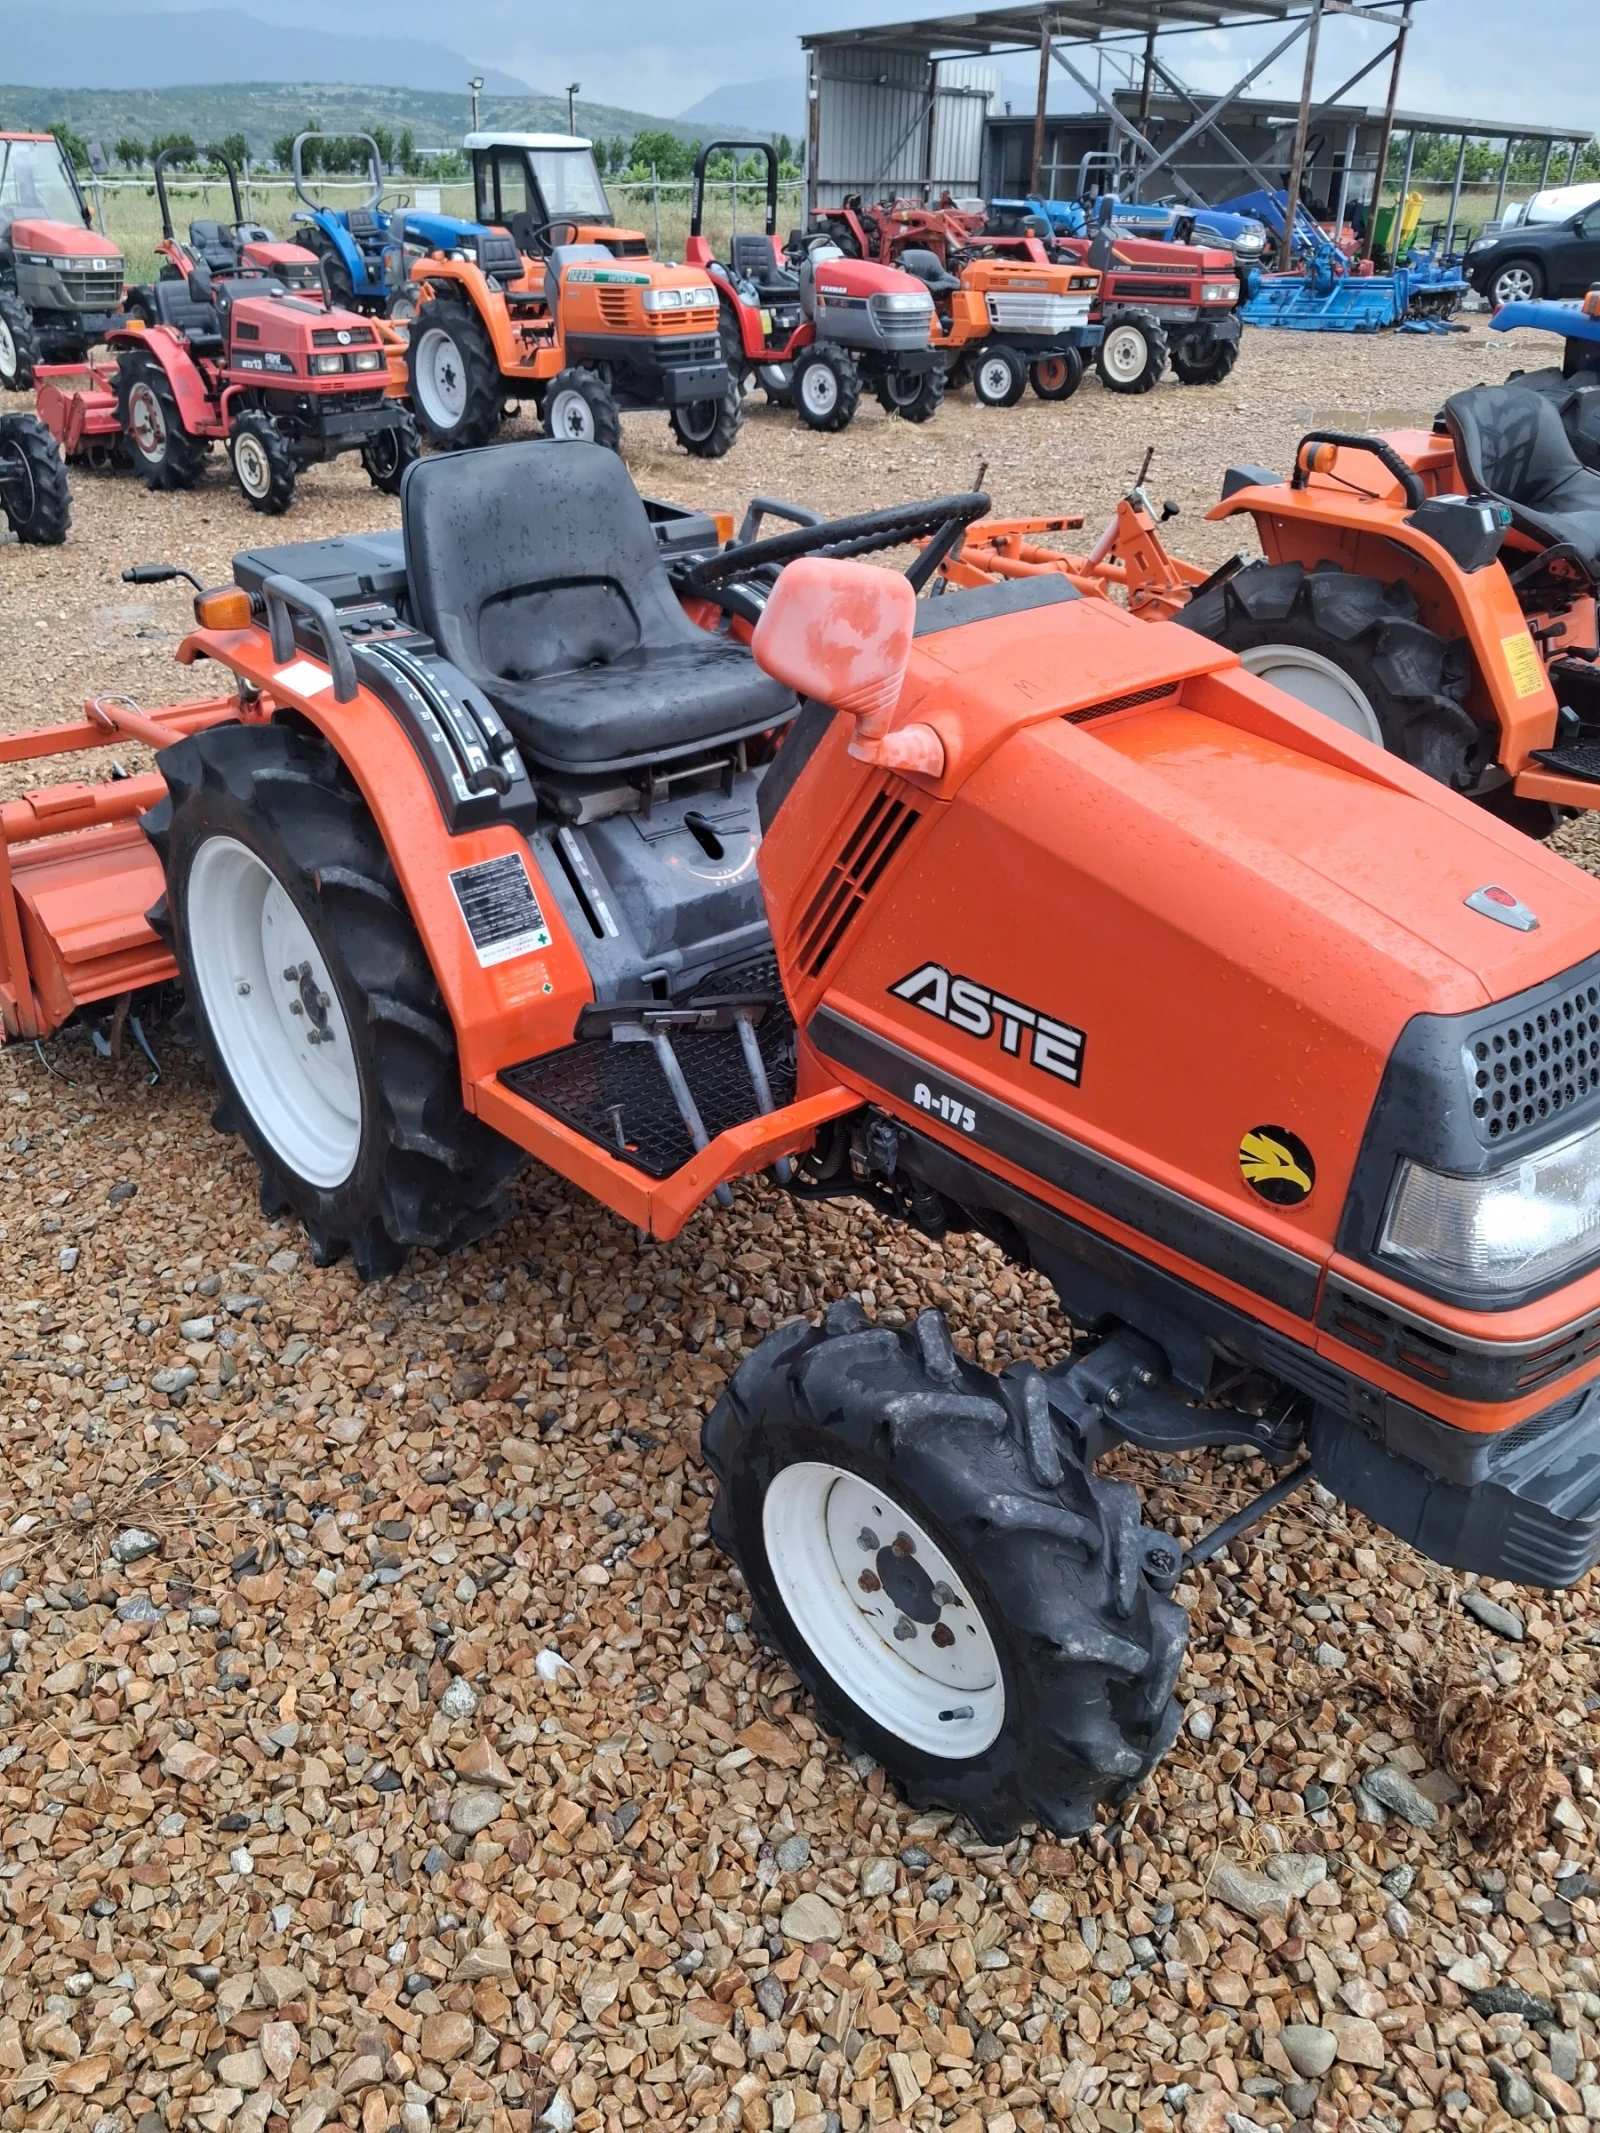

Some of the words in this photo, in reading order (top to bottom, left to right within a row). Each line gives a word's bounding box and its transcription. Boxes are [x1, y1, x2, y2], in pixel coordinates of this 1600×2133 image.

[1111, 215, 1140, 223] SEKI
[891, 964, 1084, 1083] ASTE
[913, 1082, 976, 1132] A-175
